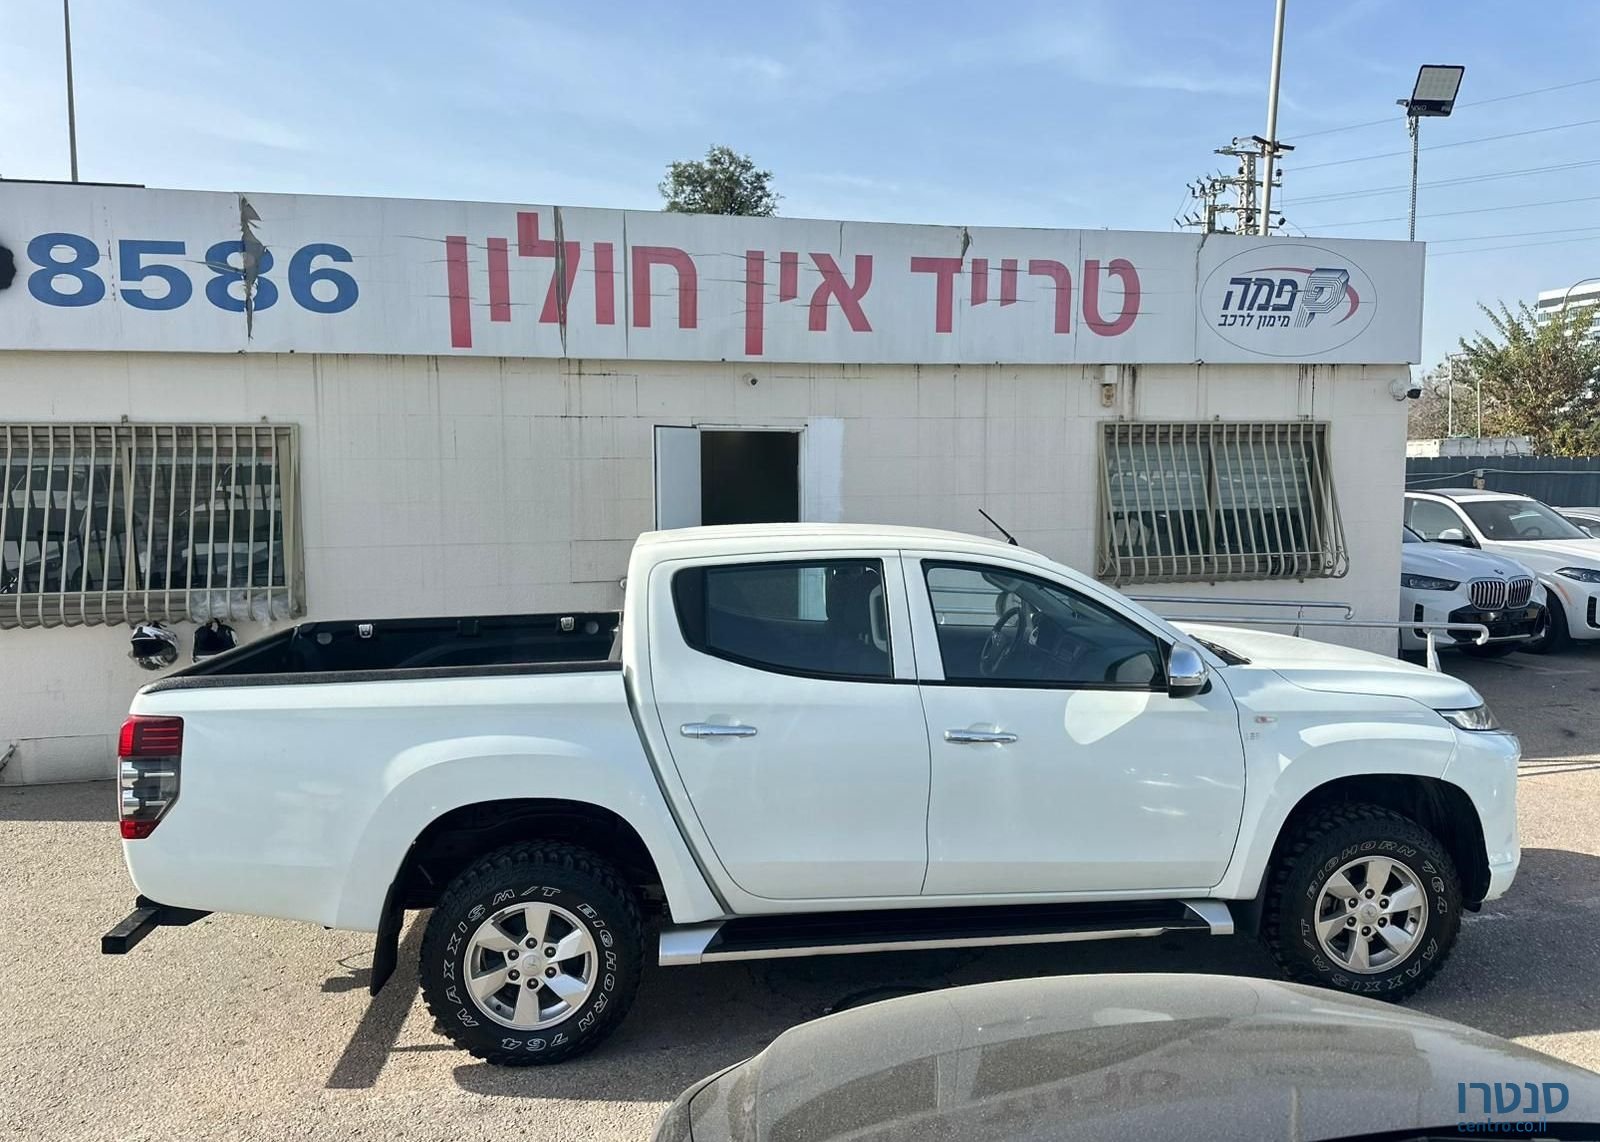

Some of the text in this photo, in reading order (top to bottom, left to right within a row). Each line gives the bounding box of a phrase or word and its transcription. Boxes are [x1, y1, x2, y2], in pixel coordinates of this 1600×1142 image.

[26, 232, 360, 314] 8586
[446, 211, 1141, 355] טרייד אין חולון
[1218, 312, 1290, 330] מימון לרכב
[1306, 840, 1416, 900] BIGHORN
[443, 886, 617, 1051] MAXXIS M/T BIGHORN 764
[1331, 938, 1439, 992] MAXXIS
